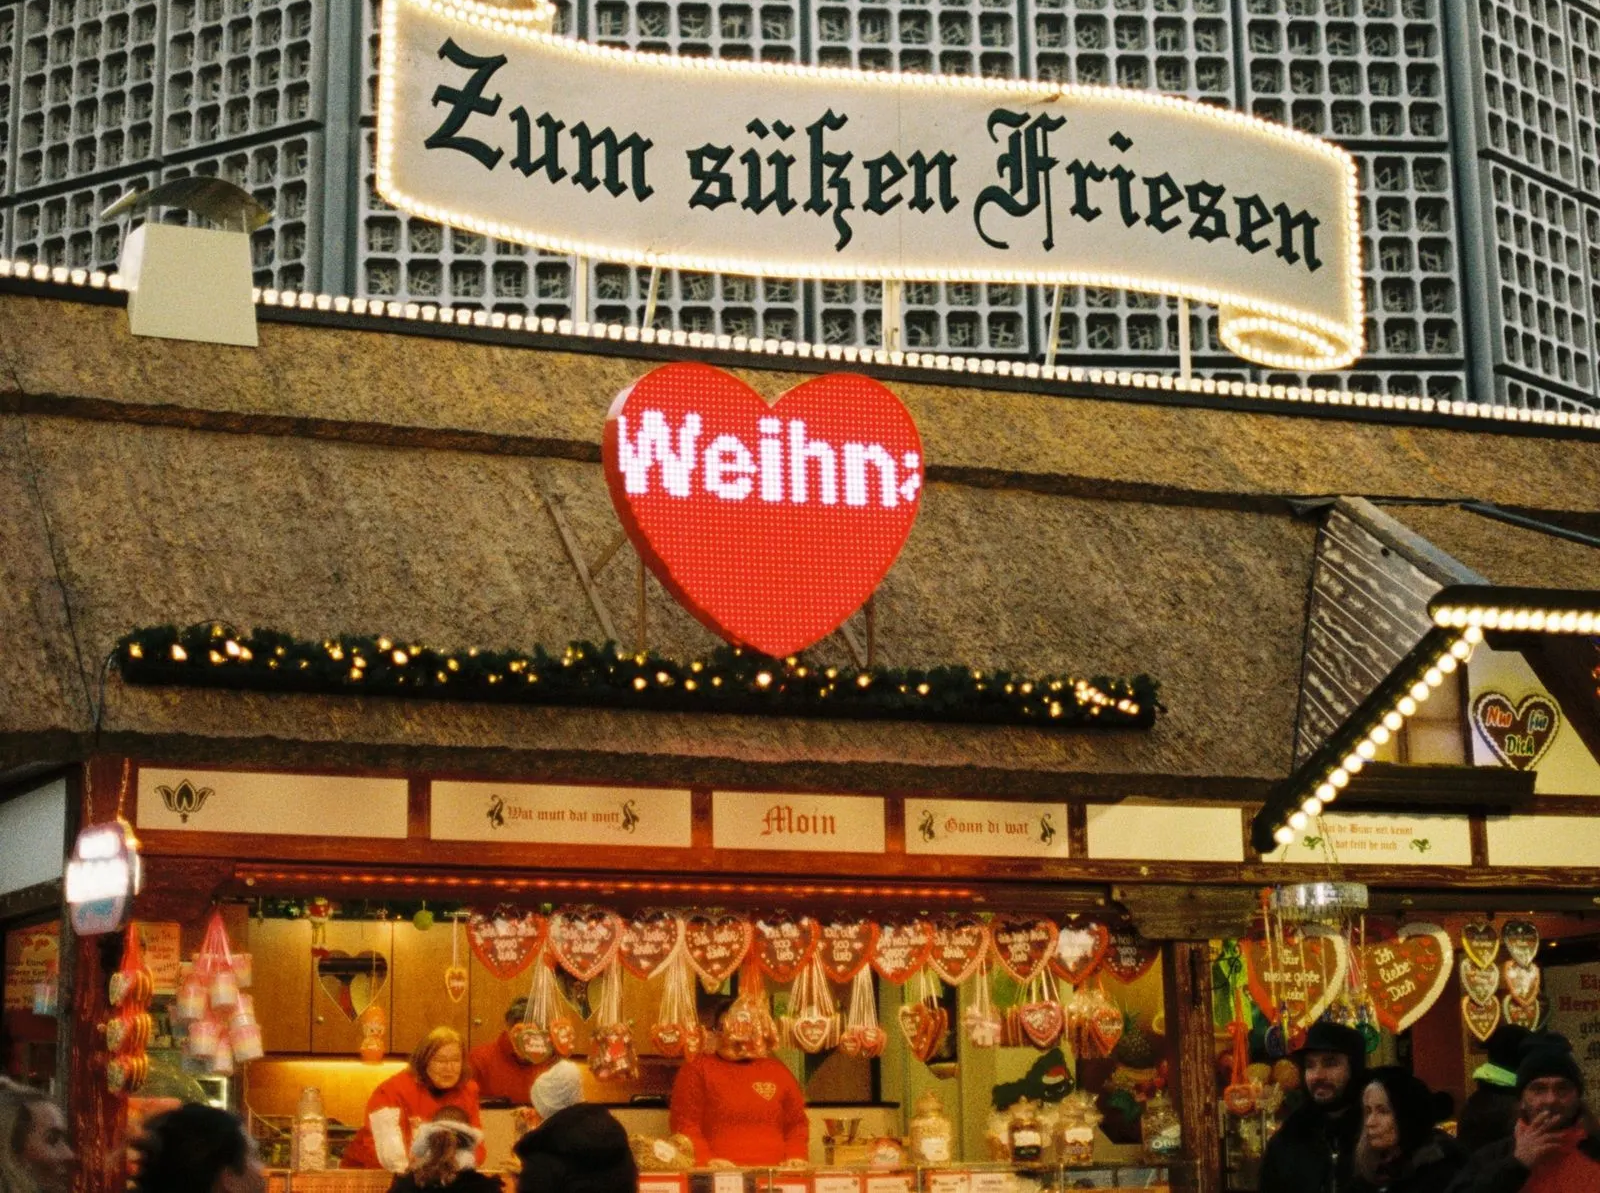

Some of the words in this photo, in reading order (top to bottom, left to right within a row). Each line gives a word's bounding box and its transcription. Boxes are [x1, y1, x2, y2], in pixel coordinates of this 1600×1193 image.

[423, 37, 655, 203] Zum
[686, 110, 960, 250] süßen
[974, 110, 1323, 273] Friesen
[1485, 705, 1513, 728] Nur
[1527, 709, 1549, 734] für
[1504, 733, 1535, 757] Dich
[508, 806, 534, 820] Wat
[538, 808, 565, 821] mutt
[569, 809, 588, 823] dat
[592, 811, 620, 823] mutt
[760, 805, 836, 835] Moin
[1005, 820, 1030, 835] wat
[1373, 947, 1396, 966] Ich
[1378, 961, 1412, 984] liebe
[1386, 979, 1416, 1002] Dich
